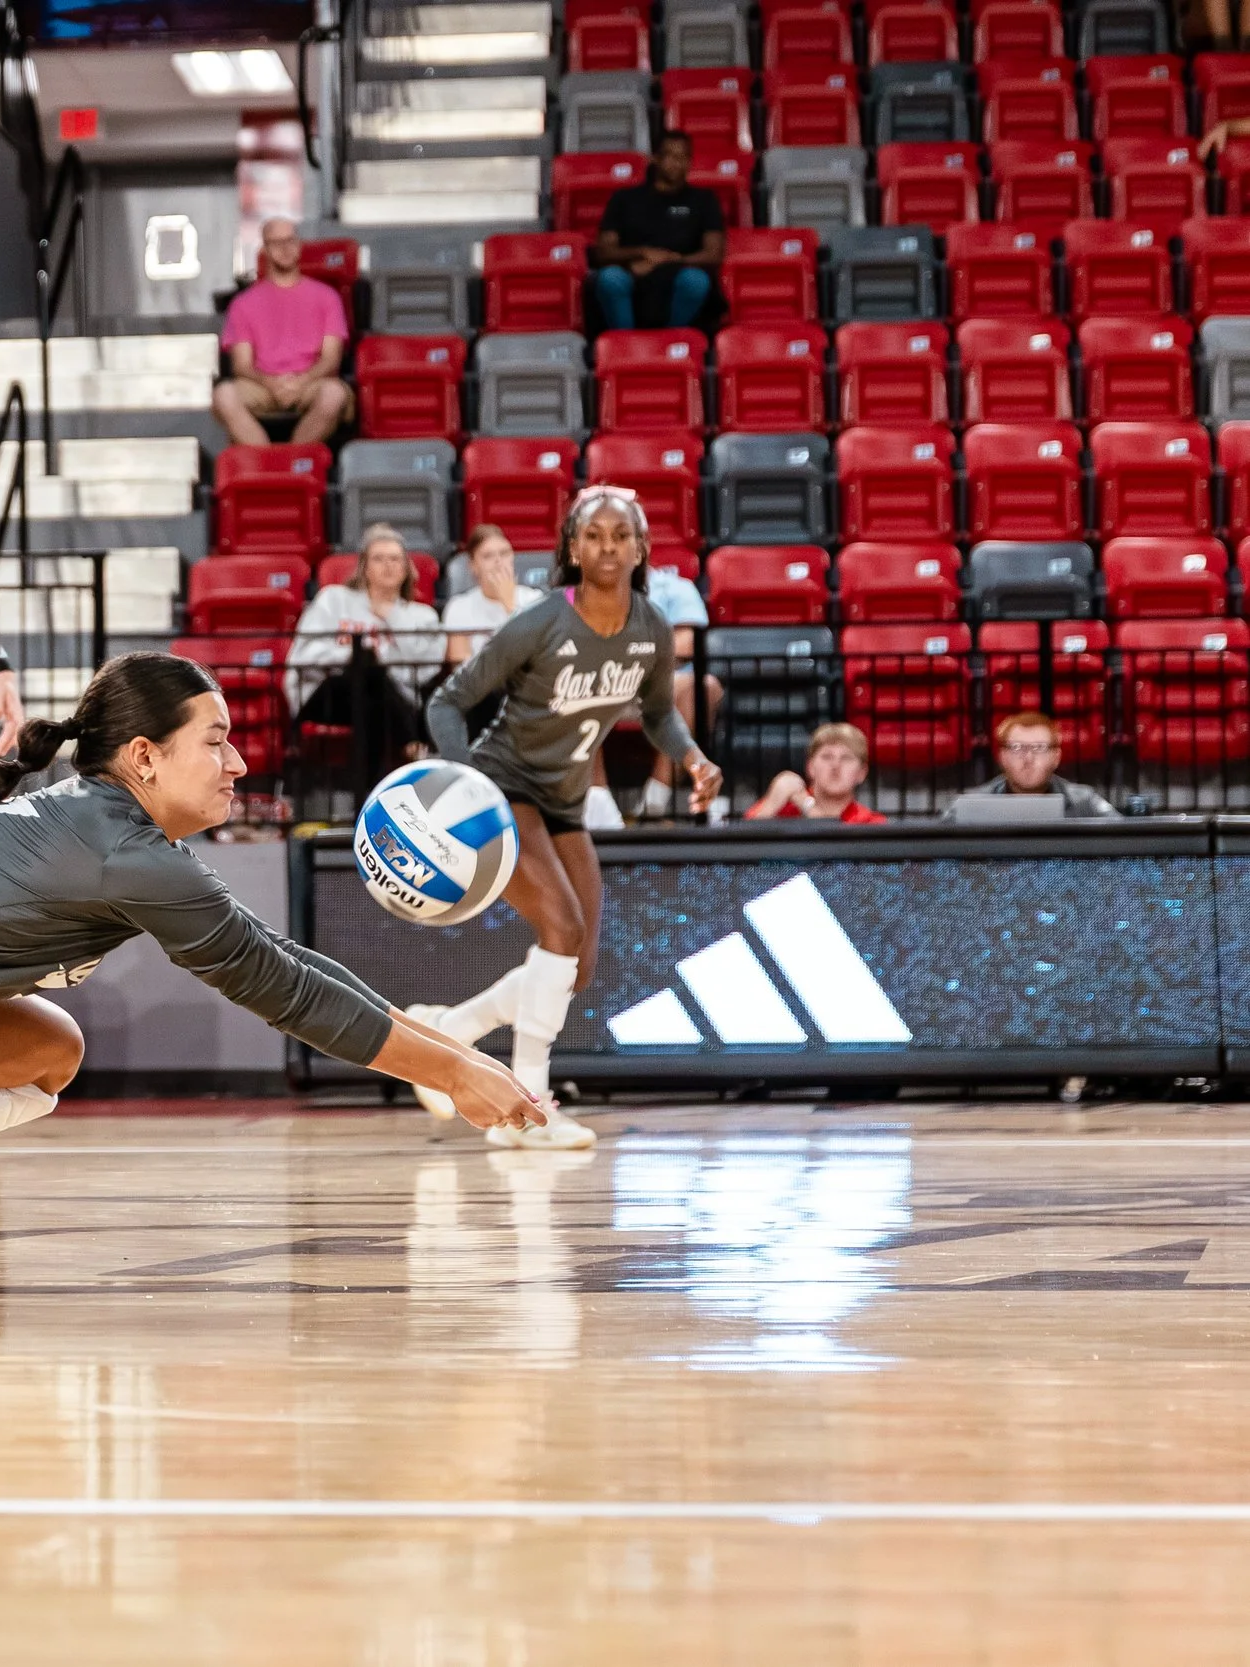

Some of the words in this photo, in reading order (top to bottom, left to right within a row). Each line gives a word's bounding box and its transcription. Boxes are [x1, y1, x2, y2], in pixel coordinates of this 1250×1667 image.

[549, 663, 598, 712] Jax
[570, 718, 601, 762] 2
[359, 838, 426, 909] molten
[373, 826, 437, 889] NCAA
